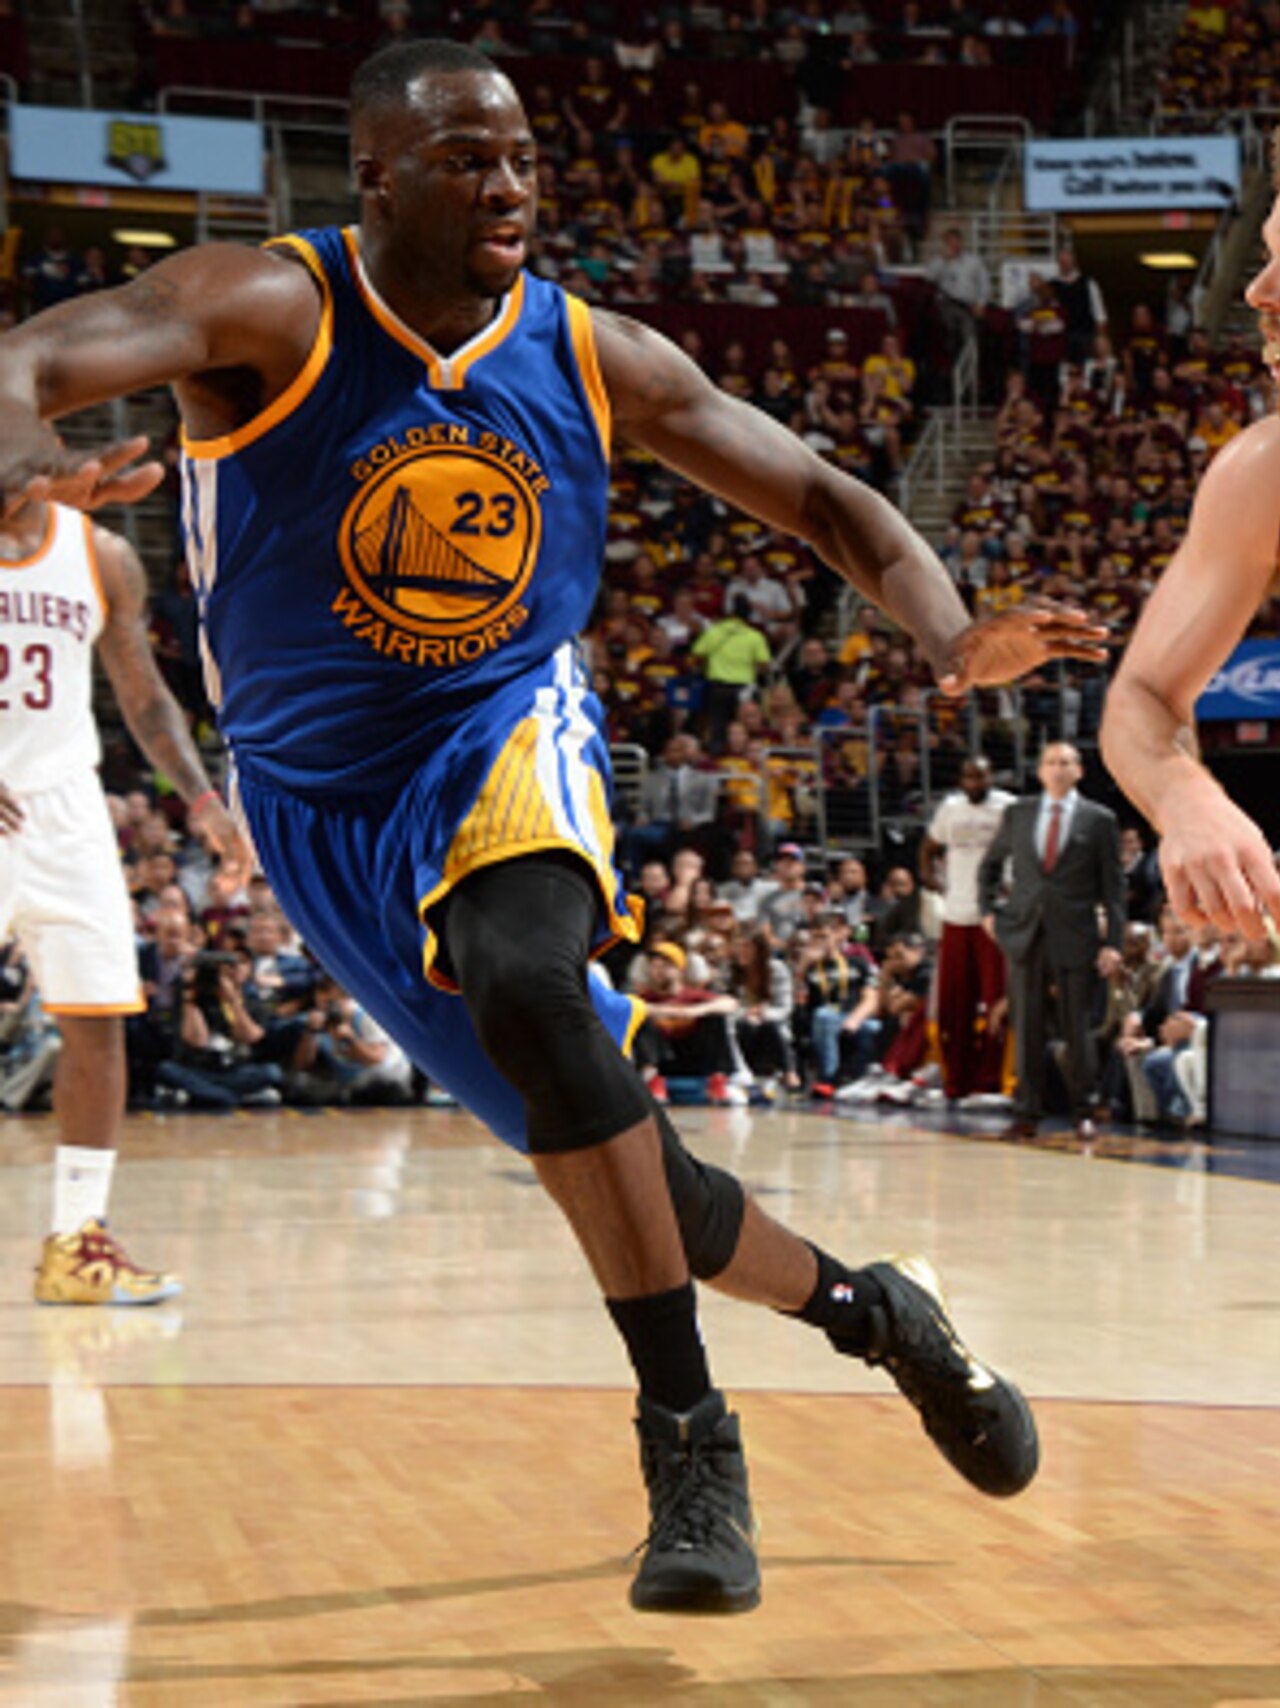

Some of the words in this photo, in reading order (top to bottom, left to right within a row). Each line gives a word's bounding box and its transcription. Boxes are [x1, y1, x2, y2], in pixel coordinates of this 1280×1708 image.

[351, 422, 468, 481] GOLDEN
[478, 430, 551, 494] STATE
[449, 491, 517, 537] 23
[330, 586, 529, 667] WARRIORS
